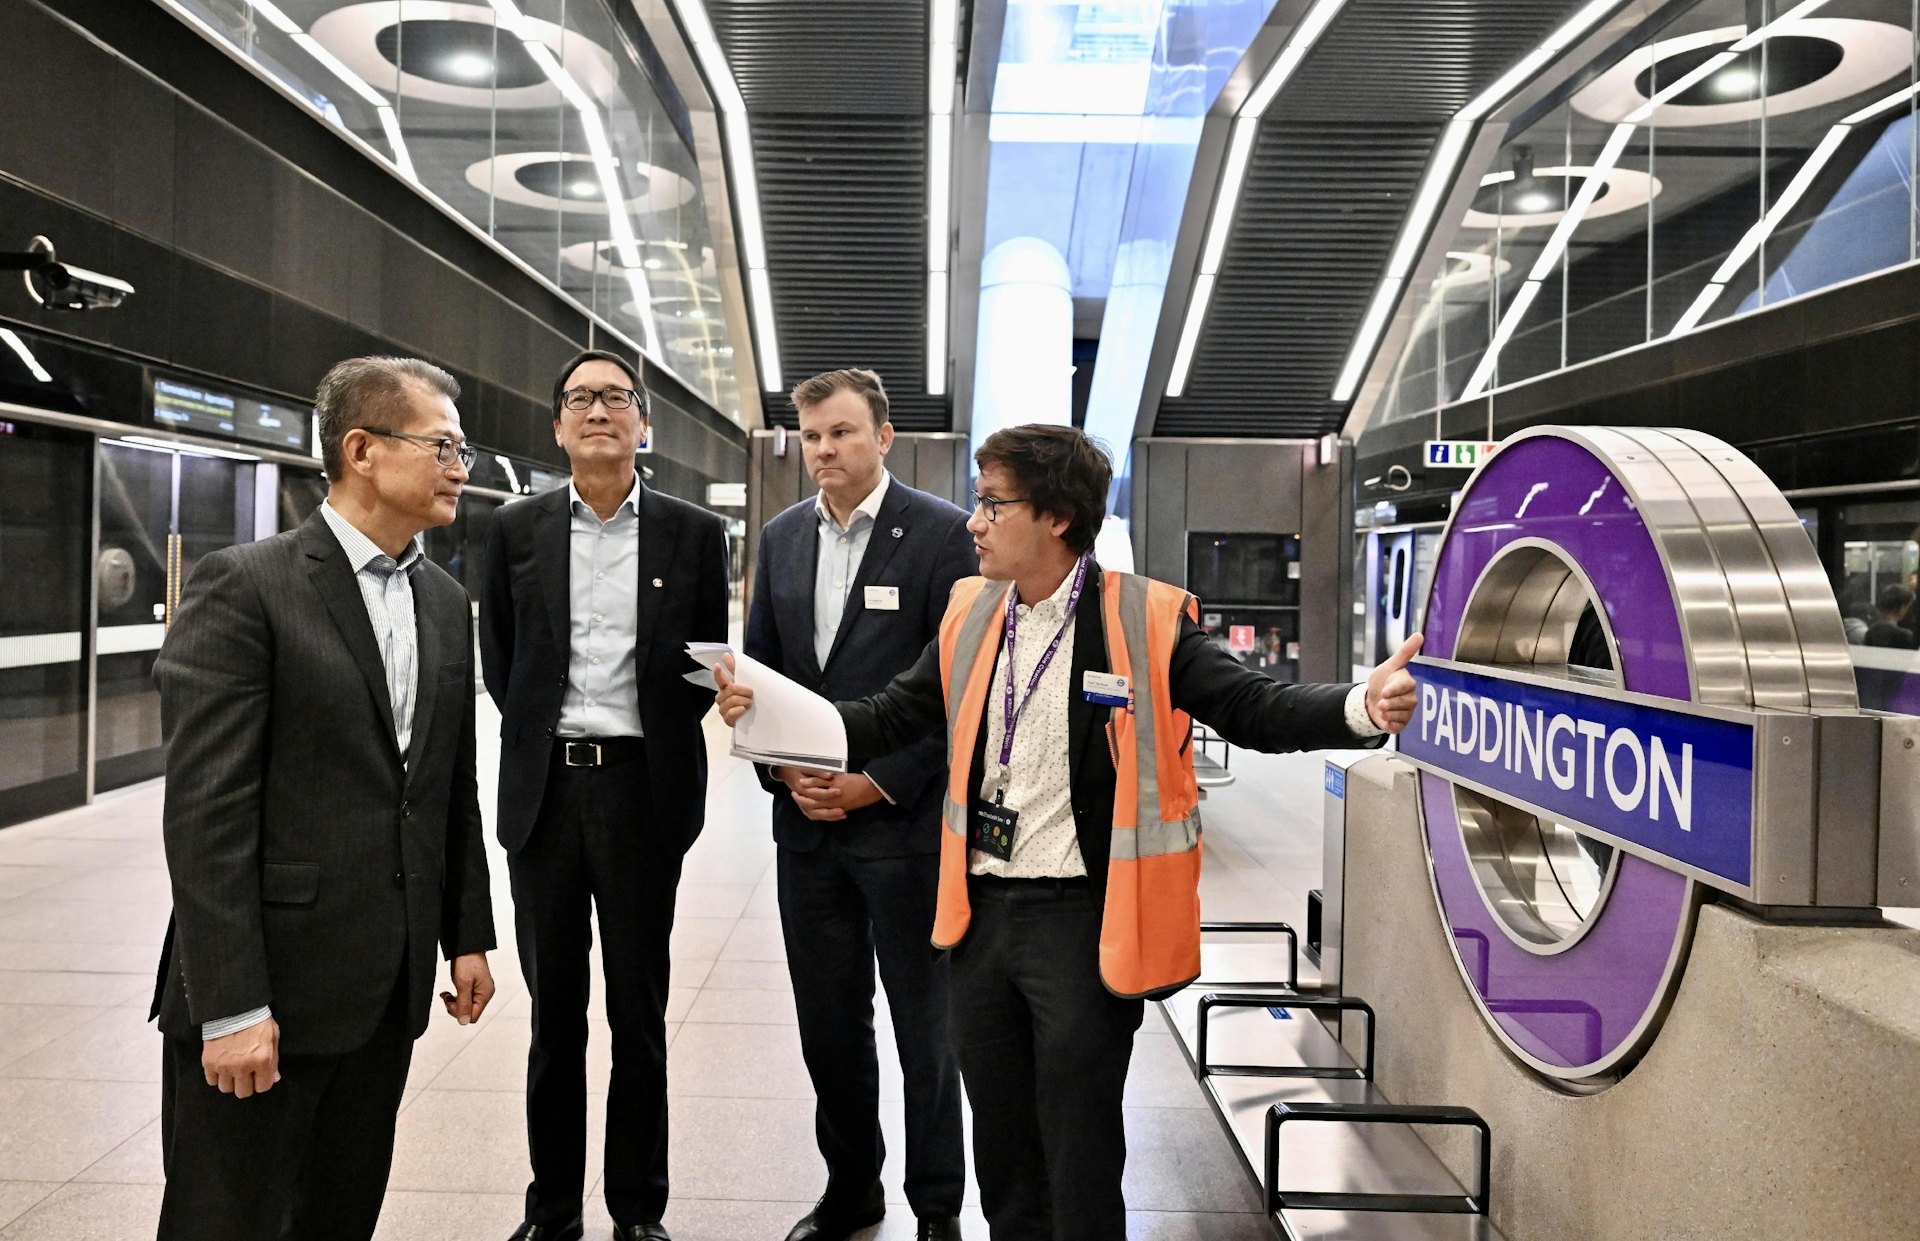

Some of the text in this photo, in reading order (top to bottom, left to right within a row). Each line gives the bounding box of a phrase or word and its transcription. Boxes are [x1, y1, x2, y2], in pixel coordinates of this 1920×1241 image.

[1076, 568, 1084, 588] Service
[1030, 650, 1054, 686] Value Creation
[1422, 683, 1693, 832] PADDINGTON
